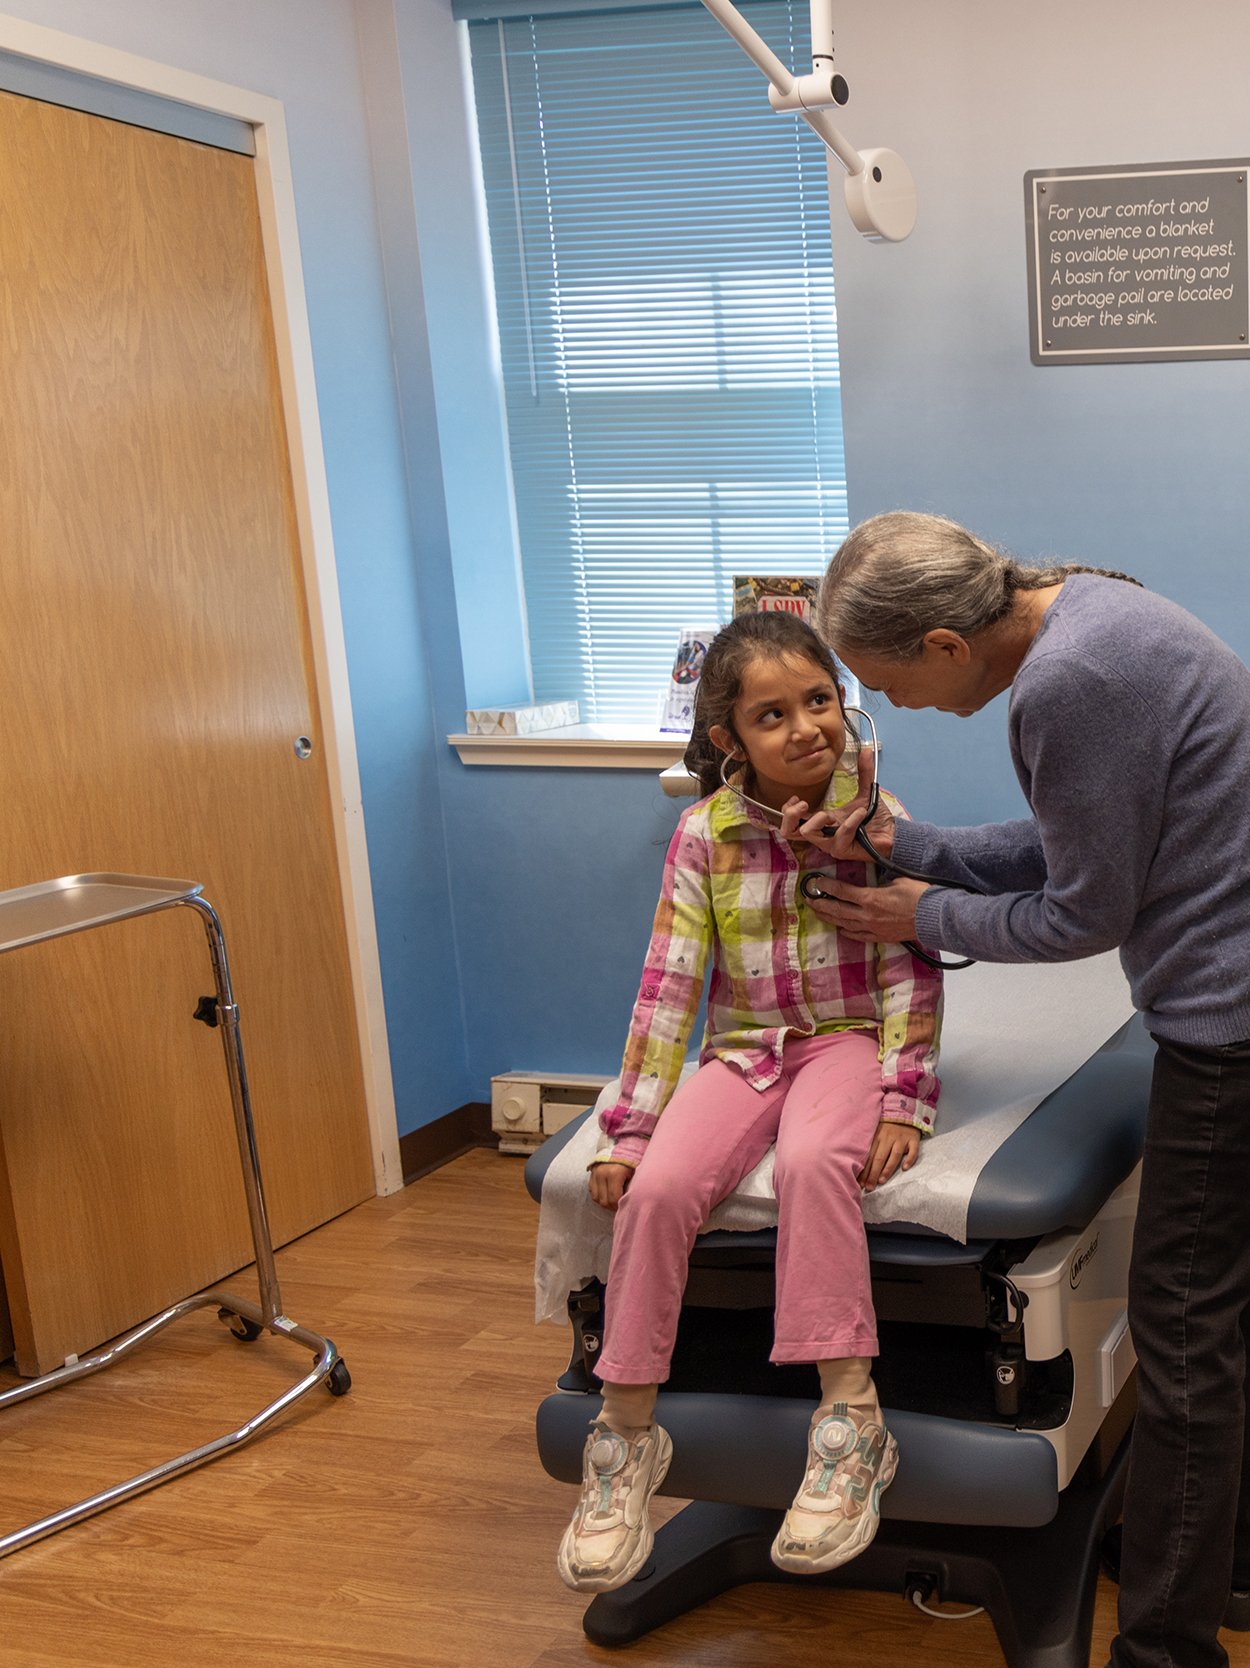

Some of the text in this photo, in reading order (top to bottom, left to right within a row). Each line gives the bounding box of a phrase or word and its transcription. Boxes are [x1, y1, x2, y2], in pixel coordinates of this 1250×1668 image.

[1048, 197, 1210, 223] For your comfort and
[1049, 218, 1215, 242] convenience a blanket
[1050, 240, 1236, 265] is available upon request.
[1051, 262, 1231, 286] A basin for vomiting and
[1051, 284, 1234, 311] garbage pail are located
[1052, 309, 1158, 328] under the sink.
